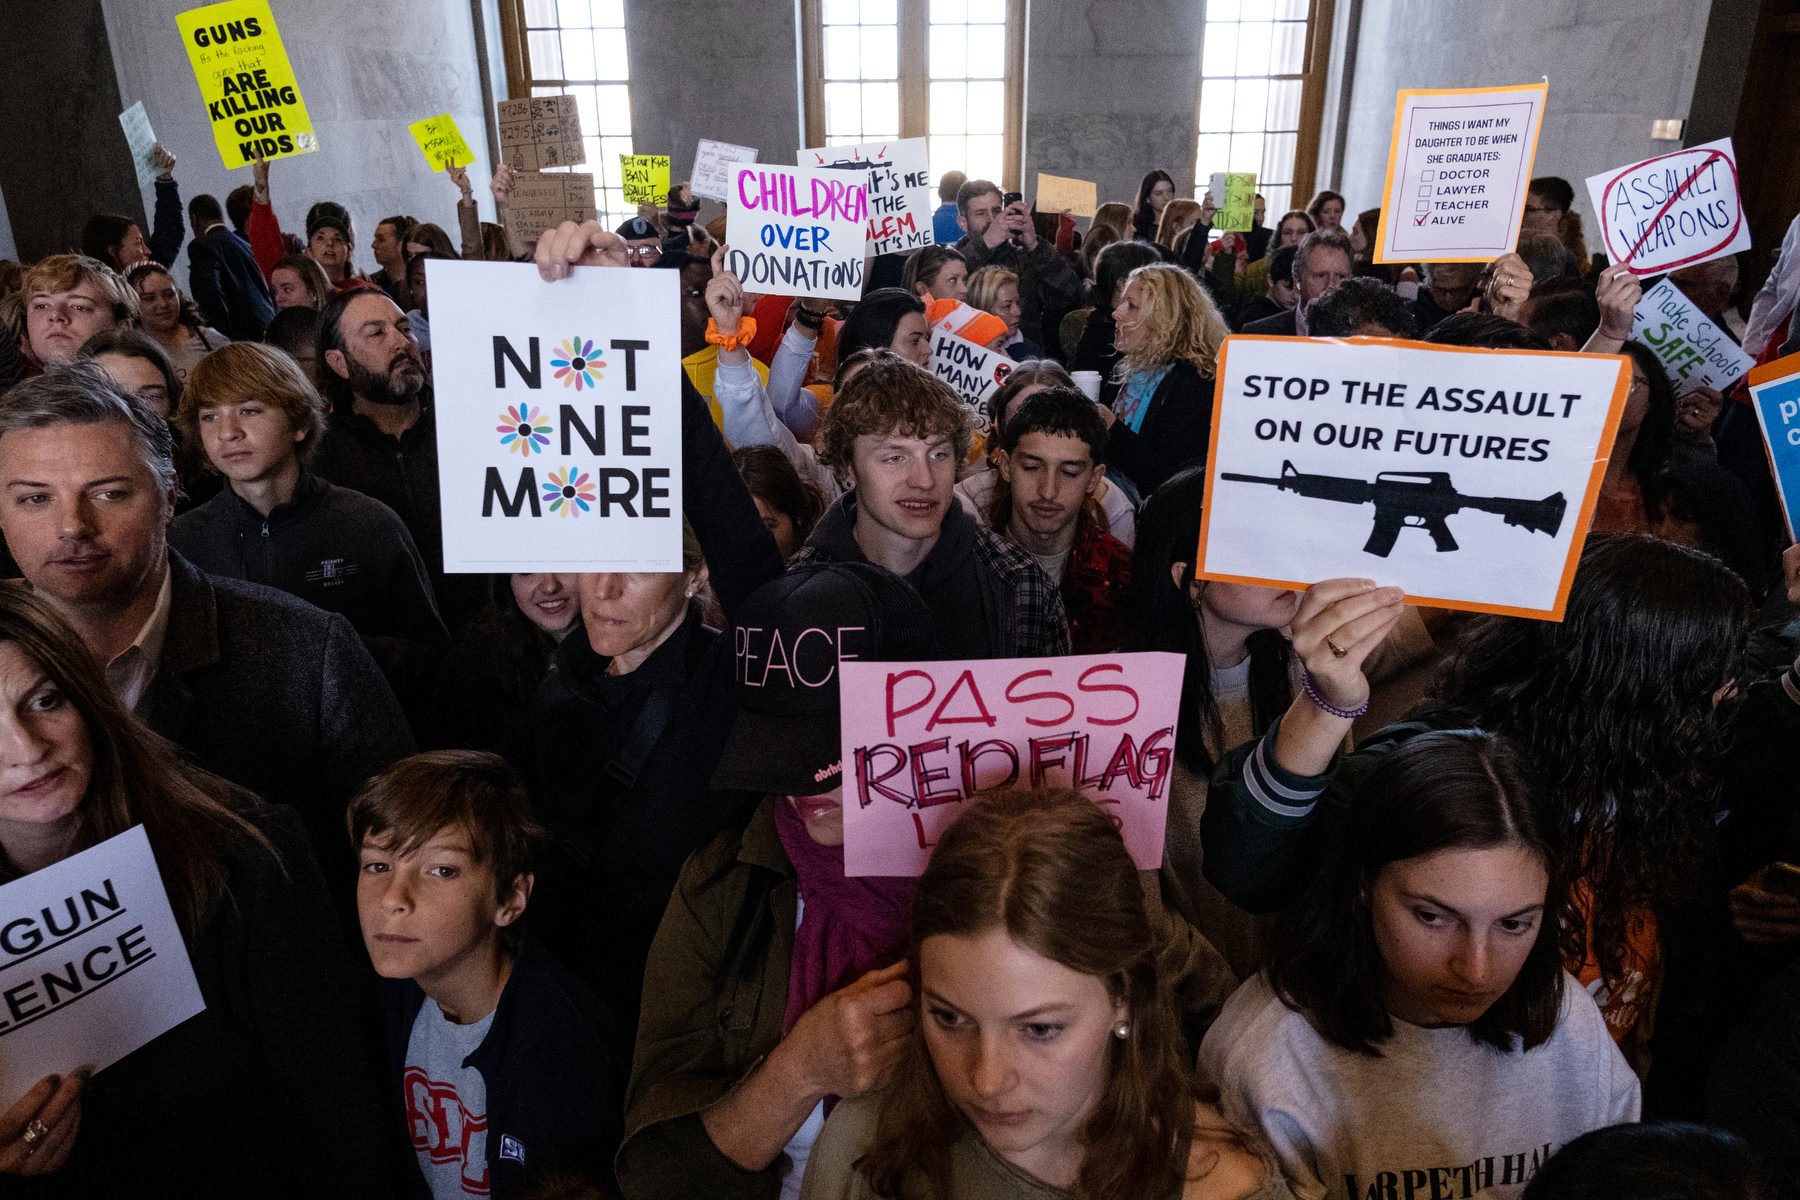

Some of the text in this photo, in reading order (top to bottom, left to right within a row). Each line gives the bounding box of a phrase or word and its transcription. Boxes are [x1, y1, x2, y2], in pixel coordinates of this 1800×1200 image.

[194, 17, 262, 48] GUNS
[237, 57, 262, 72] that
[223, 69, 272, 96] ARE
[209, 86, 297, 122] KILLING
[234, 112, 286, 137] OUR
[1429, 117, 1510, 131] THINGS I WANT MY
[239, 135, 294, 162] KIDS
[1415, 134, 1518, 148] DAUGHTER TO BE WHEN
[1426, 151, 1501, 164] SHE GRADUATES:
[625, 169, 649, 183] BAN
[904, 171, 928, 189] ME
[1439, 169, 1490, 180] DOCTOR
[737, 169, 868, 225] CHILDREN
[1436, 184, 1486, 196] LAWYER
[1614, 158, 1720, 222] ASSAULT
[872, 195, 907, 215] THE
[1434, 200, 1489, 211] TEACHER
[1431, 216, 1466, 225] ALIVE
[1619, 199, 1729, 260] WEAPONS
[761, 223, 833, 253] OVER
[875, 230, 931, 256] IT'S ME
[936, 337, 988, 371] HOW
[1642, 322, 1706, 379] SAFE
[936, 363, 992, 397] MANY
[1243, 375, 1581, 418] STOP THE ASSAULT
[1254, 418, 1550, 462] ON OUR FUTURES
[885, 663, 1139, 737] PASS
[854, 725, 1175, 809] RED FLAG
[0, 878, 121, 955] GUN
